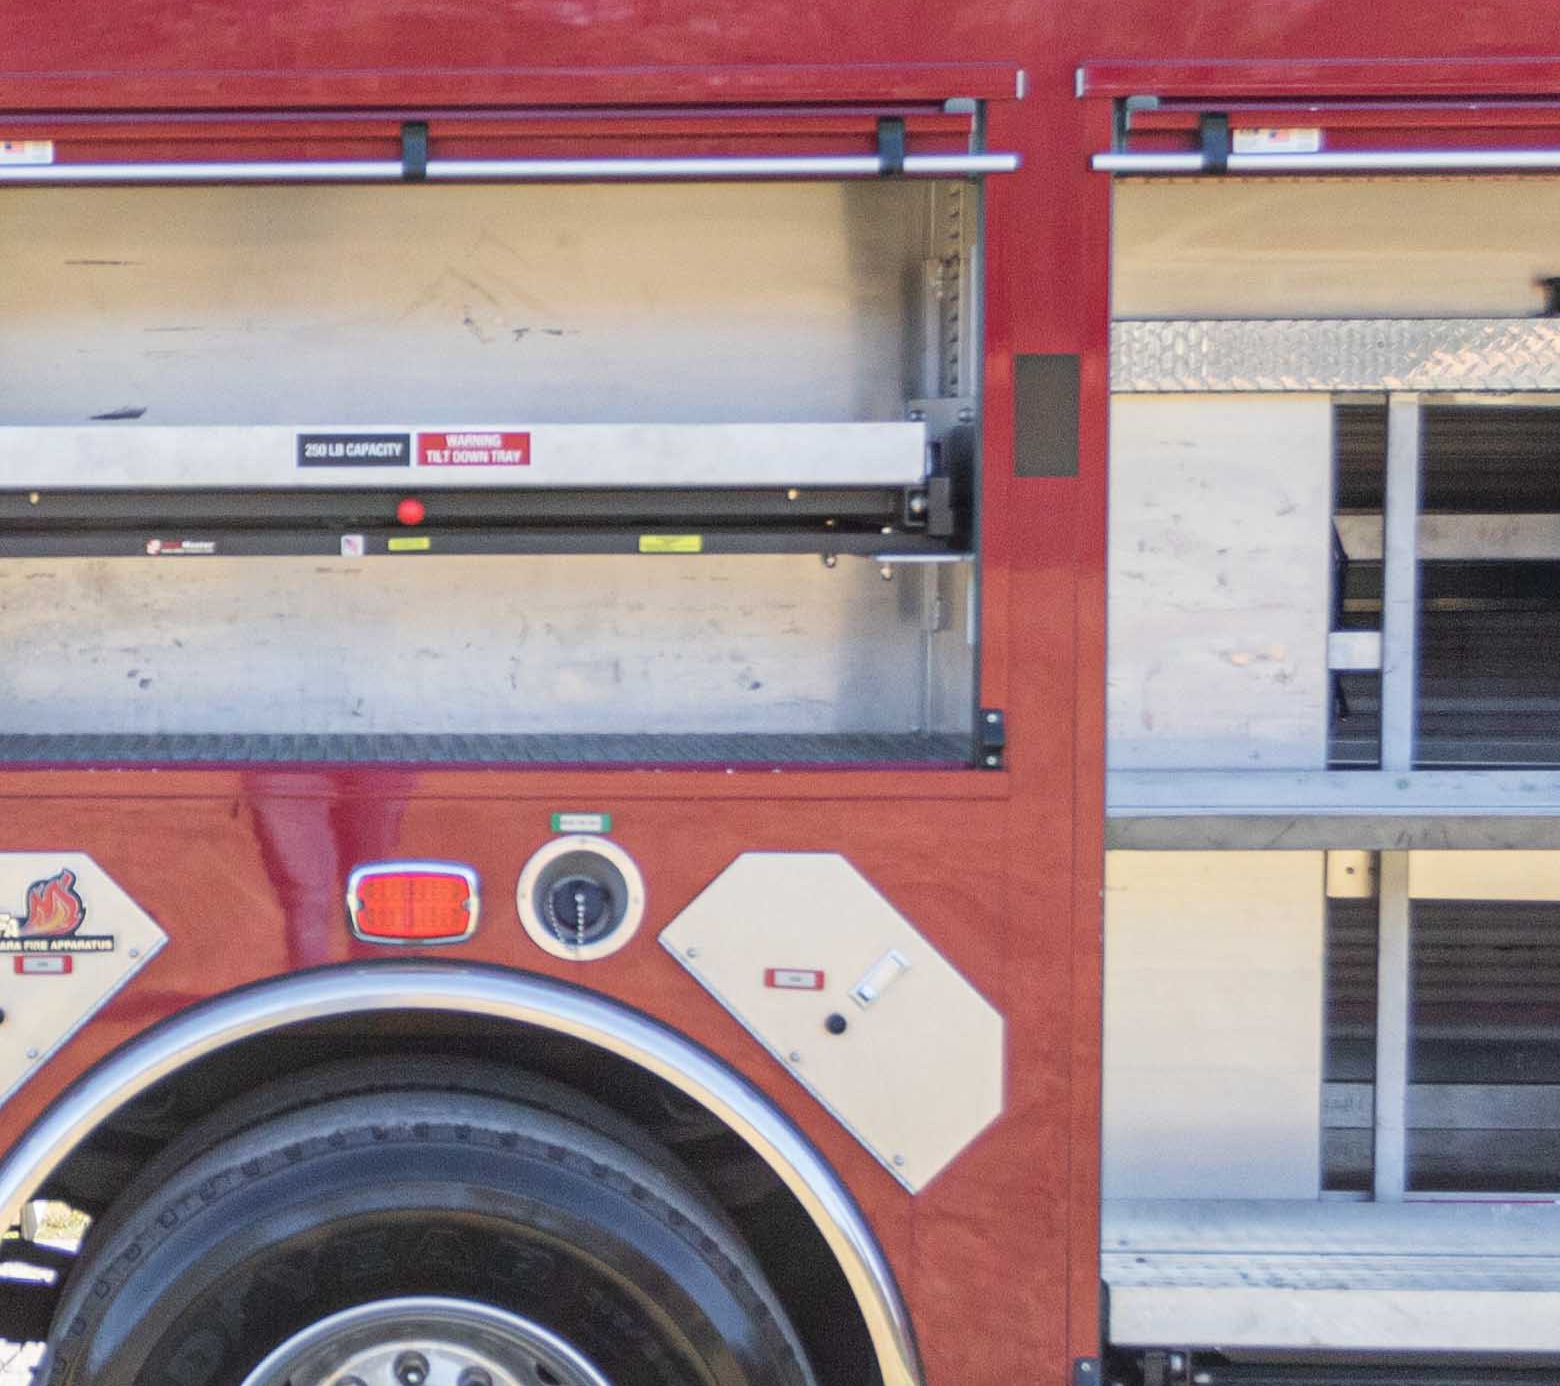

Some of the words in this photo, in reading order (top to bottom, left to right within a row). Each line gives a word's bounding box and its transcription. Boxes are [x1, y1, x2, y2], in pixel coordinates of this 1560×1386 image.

[445, 434, 502, 448] WARNING
[305, 443, 327, 457] 250
[329, 442, 344, 457] LB
[346, 442, 403, 457] CAPACITY
[426, 450, 450, 464] TILT
[452, 449, 489, 463] DOWN
[491, 449, 521, 463] TRAY
[23, 939, 48, 951] FIRE
[50, 939, 113, 951] APPARATUS
